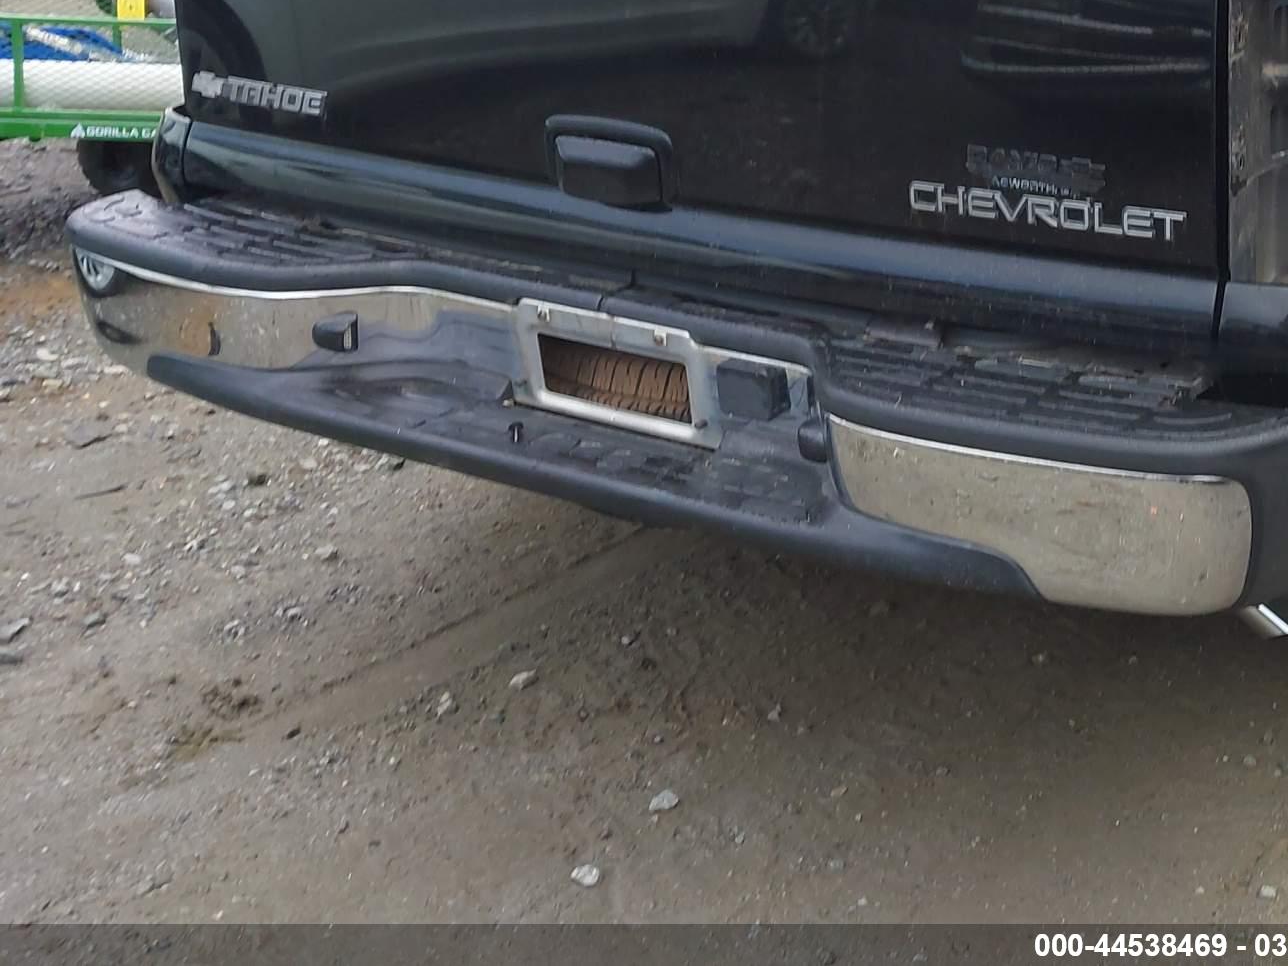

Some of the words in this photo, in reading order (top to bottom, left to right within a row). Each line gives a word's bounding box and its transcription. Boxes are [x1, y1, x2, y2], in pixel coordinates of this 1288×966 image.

[227, 75, 328, 117] TAHOE
[86, 125, 139, 139] GORILLA
[908, 179, 1188, 242] CHEVROLET
